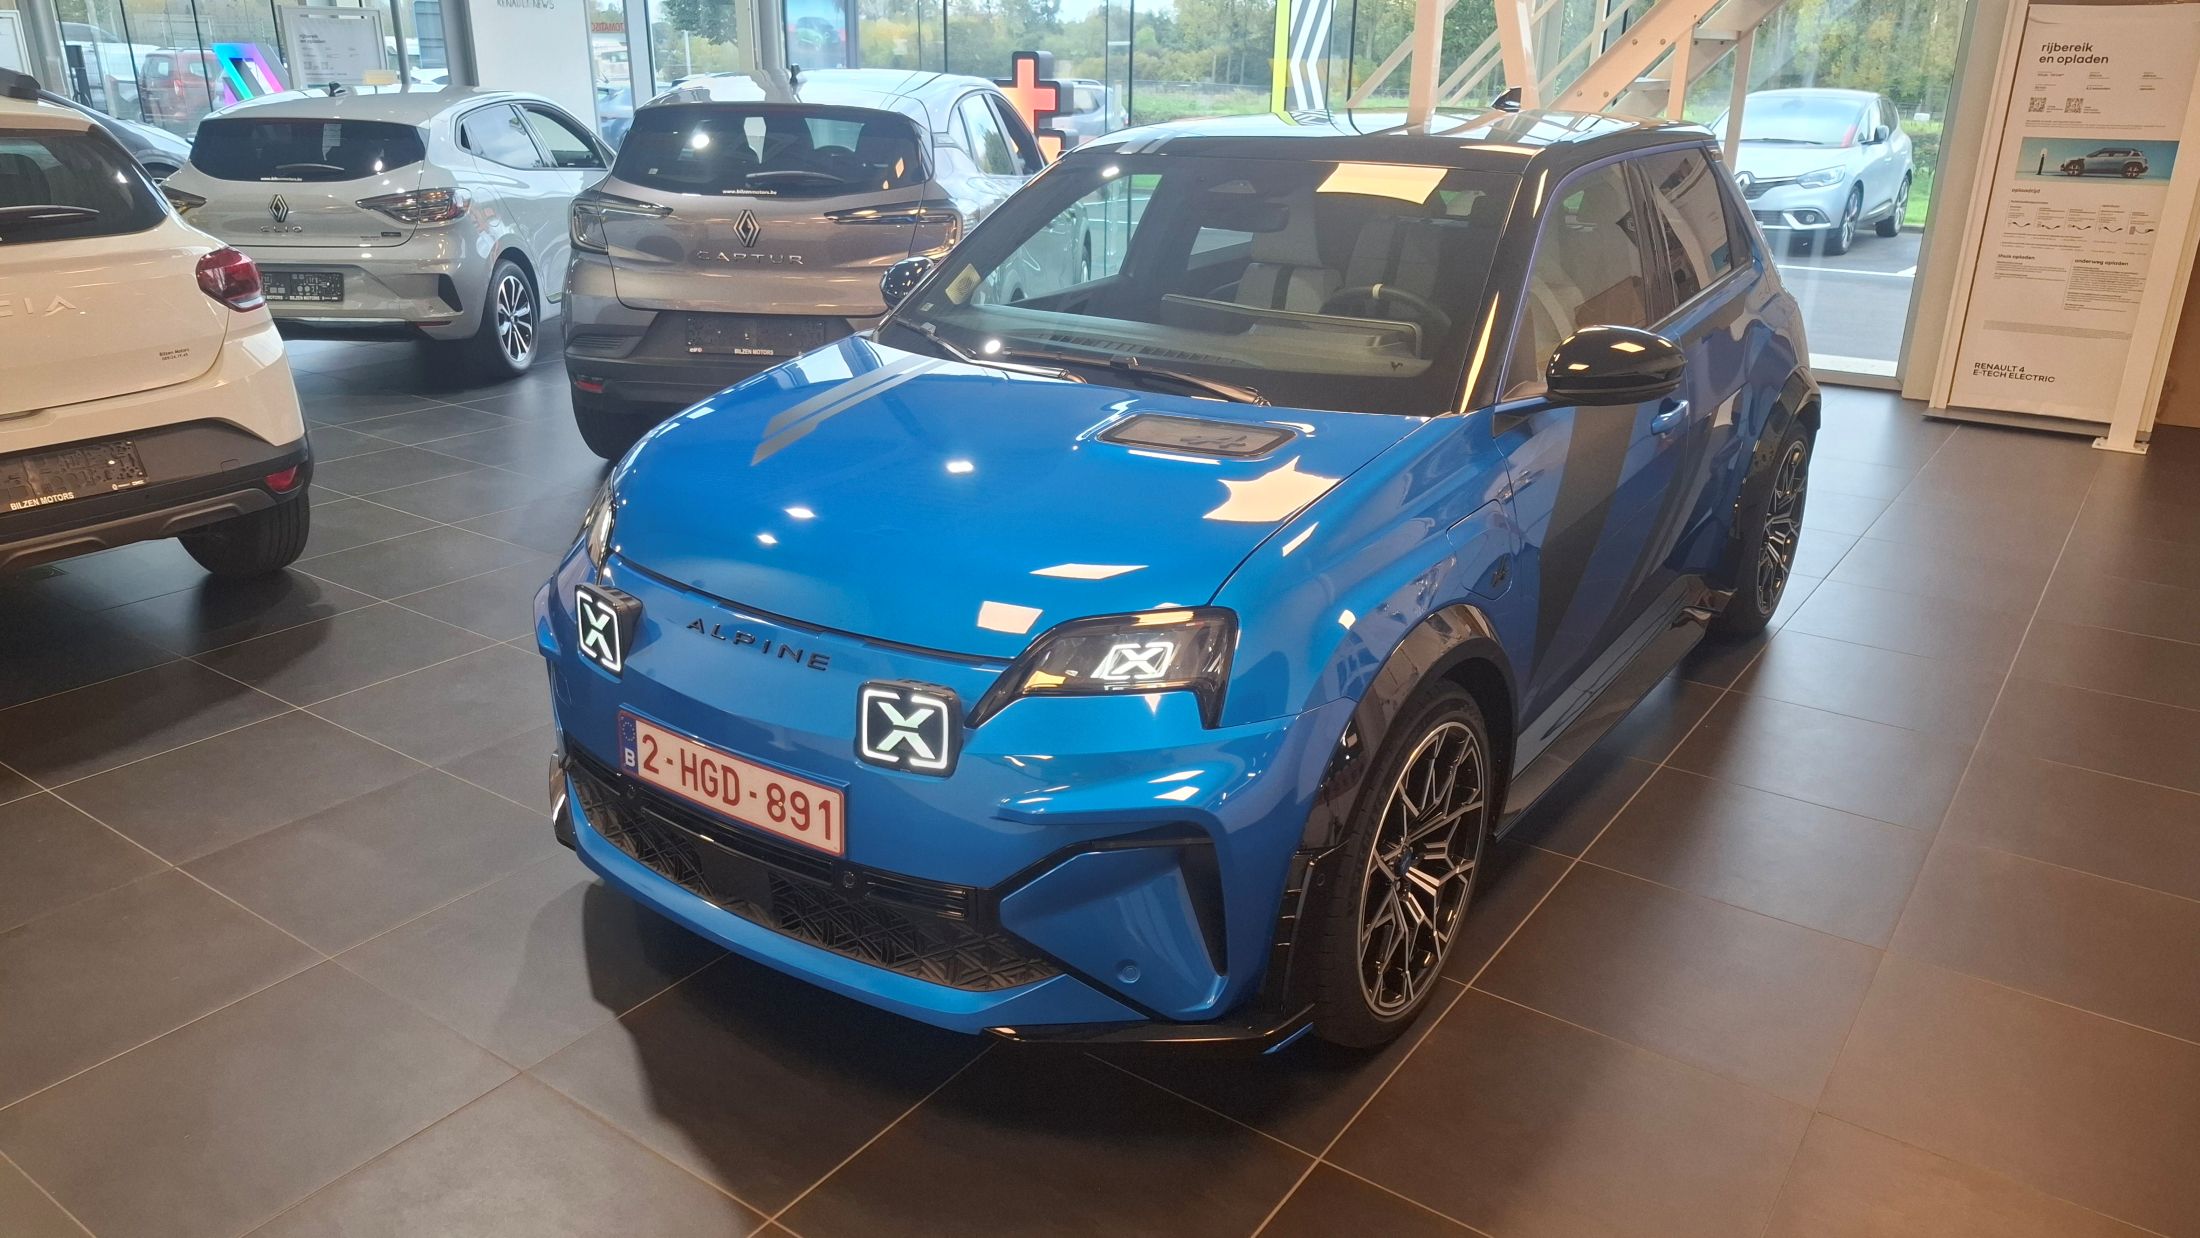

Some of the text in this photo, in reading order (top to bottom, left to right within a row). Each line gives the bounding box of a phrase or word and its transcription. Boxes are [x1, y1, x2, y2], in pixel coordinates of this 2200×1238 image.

[2041, 42, 2094, 54] rijbereik
[2039, 54, 2109, 65] en opladen
[259, 225, 303, 233] CLIO
[697, 250, 804, 265] CAPTUR
[1974, 362, 2018, 372] RENAULT
[1973, 369, 2056, 383] E-TECH ELECTRIC
[10, 491, 75, 511] BILZEN MOTORS
[686, 618, 831, 672] ALPINE
[624, 748, 636, 767] B
[642, 734, 831, 841] 2-HGD-891
